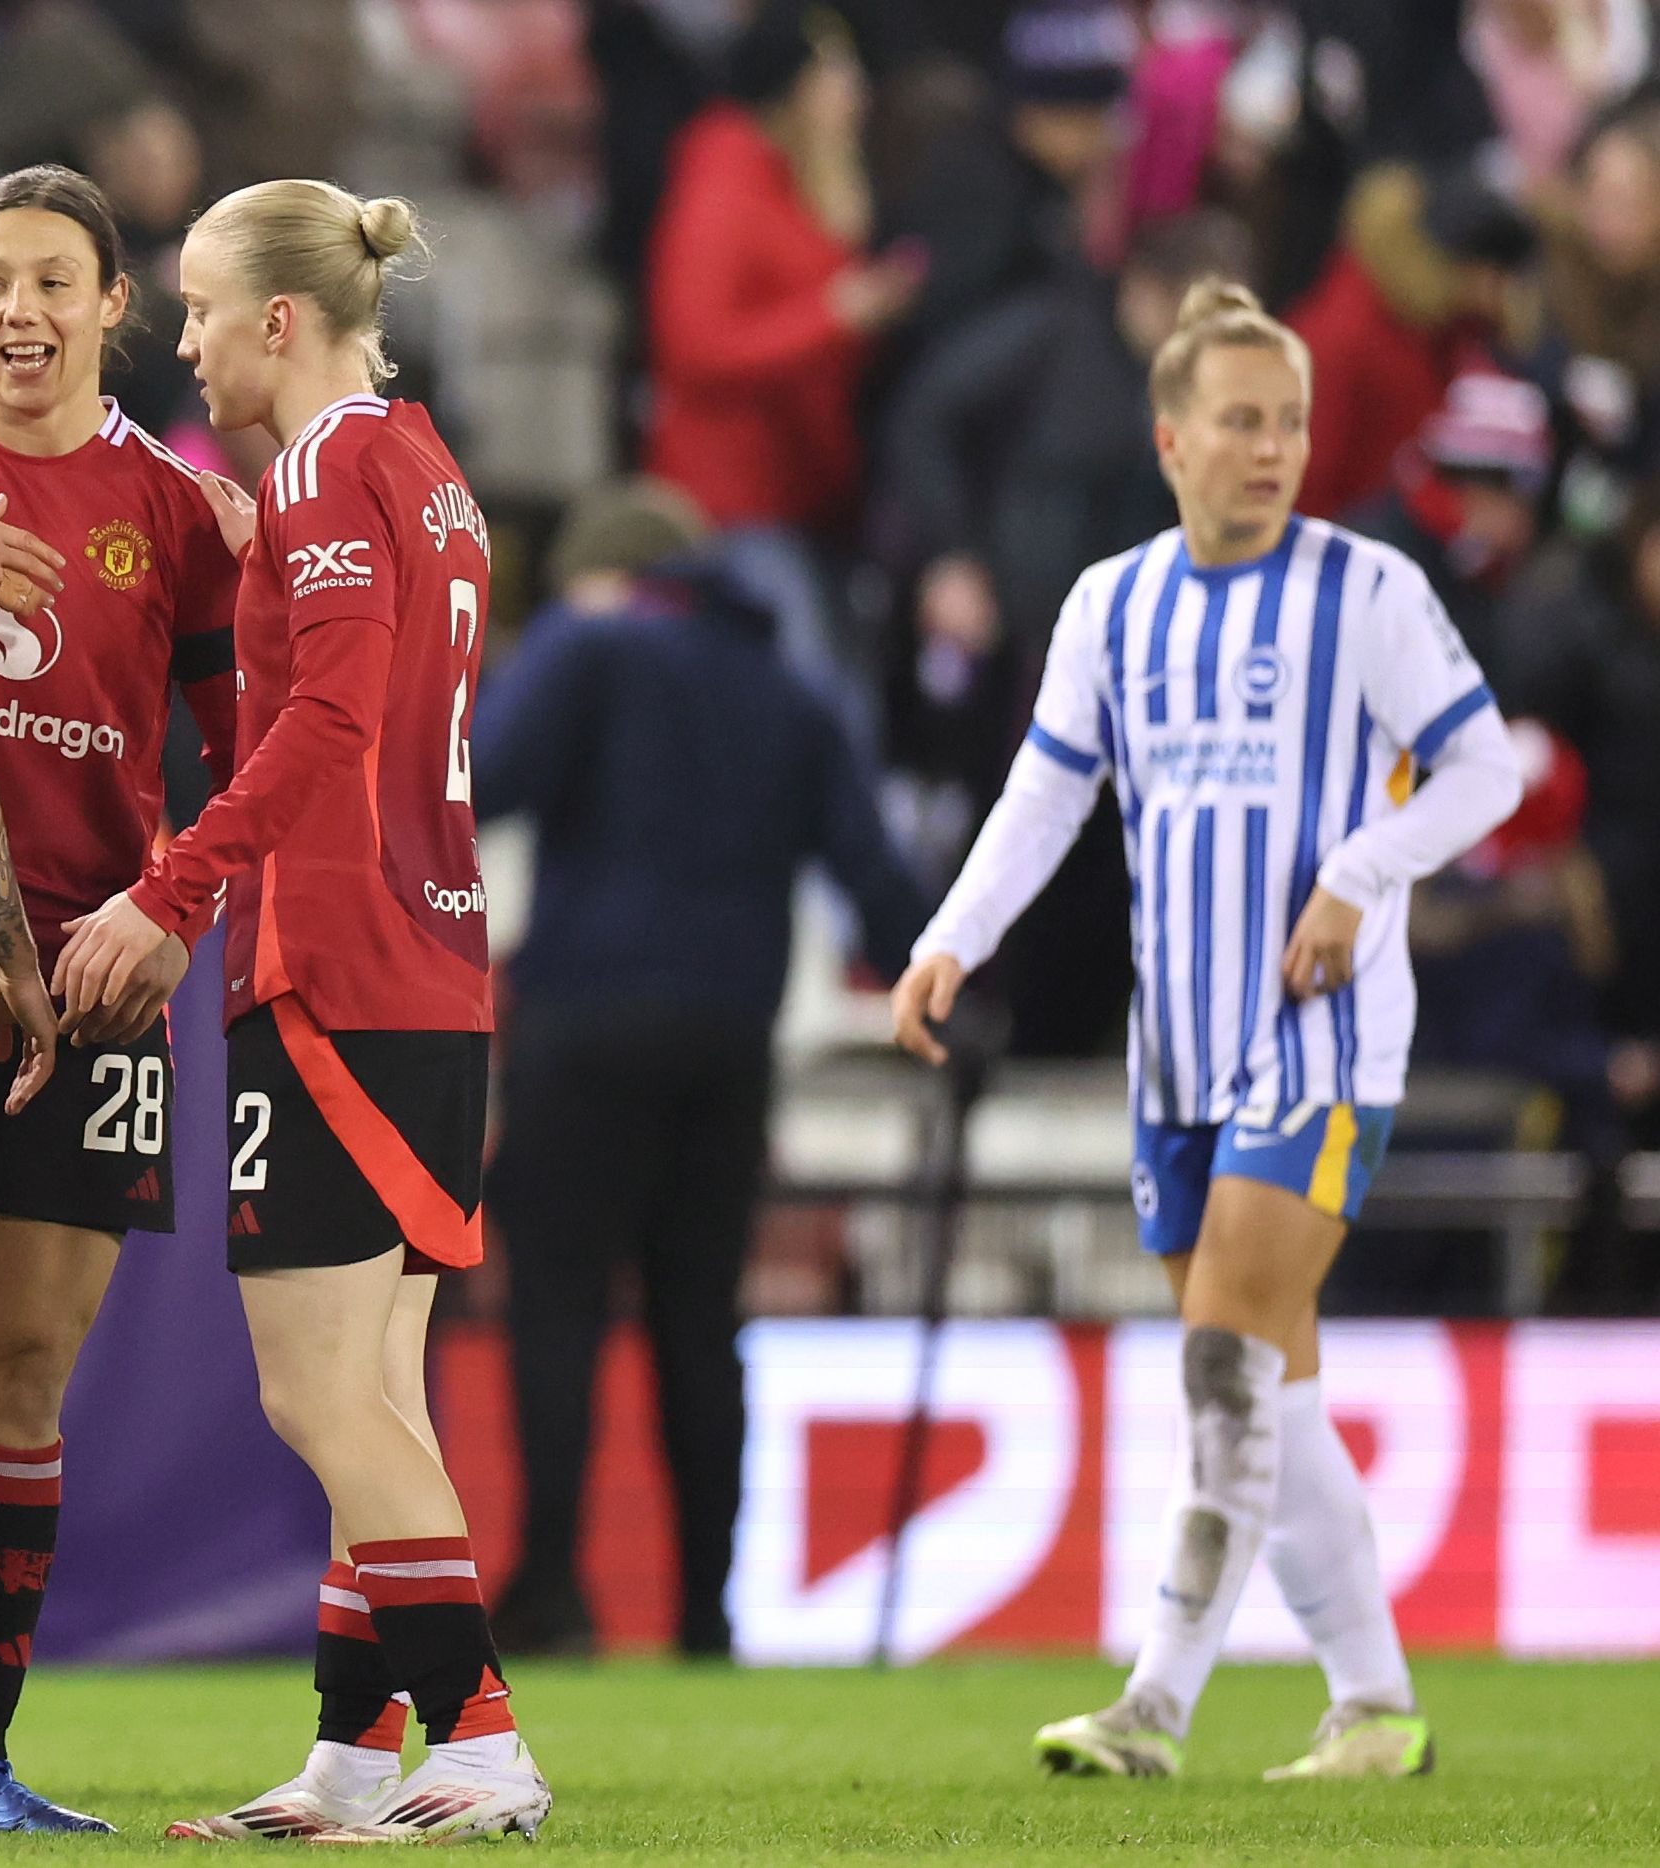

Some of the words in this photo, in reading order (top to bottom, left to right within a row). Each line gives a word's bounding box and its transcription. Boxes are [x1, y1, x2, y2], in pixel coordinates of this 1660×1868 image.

[422, 483, 491, 574] SANDBER
[98, 569, 137, 586] UNITED
[286, 540, 372, 588] DXC
[293, 576, 373, 601] TECHNOLOGY
[446, 578, 478, 807] 2
[423, 880, 486, 919] Copil
[83, 1053, 164, 1155] 28
[229, 1091, 272, 1191] 2
[423, 1784, 497, 1802] F50
